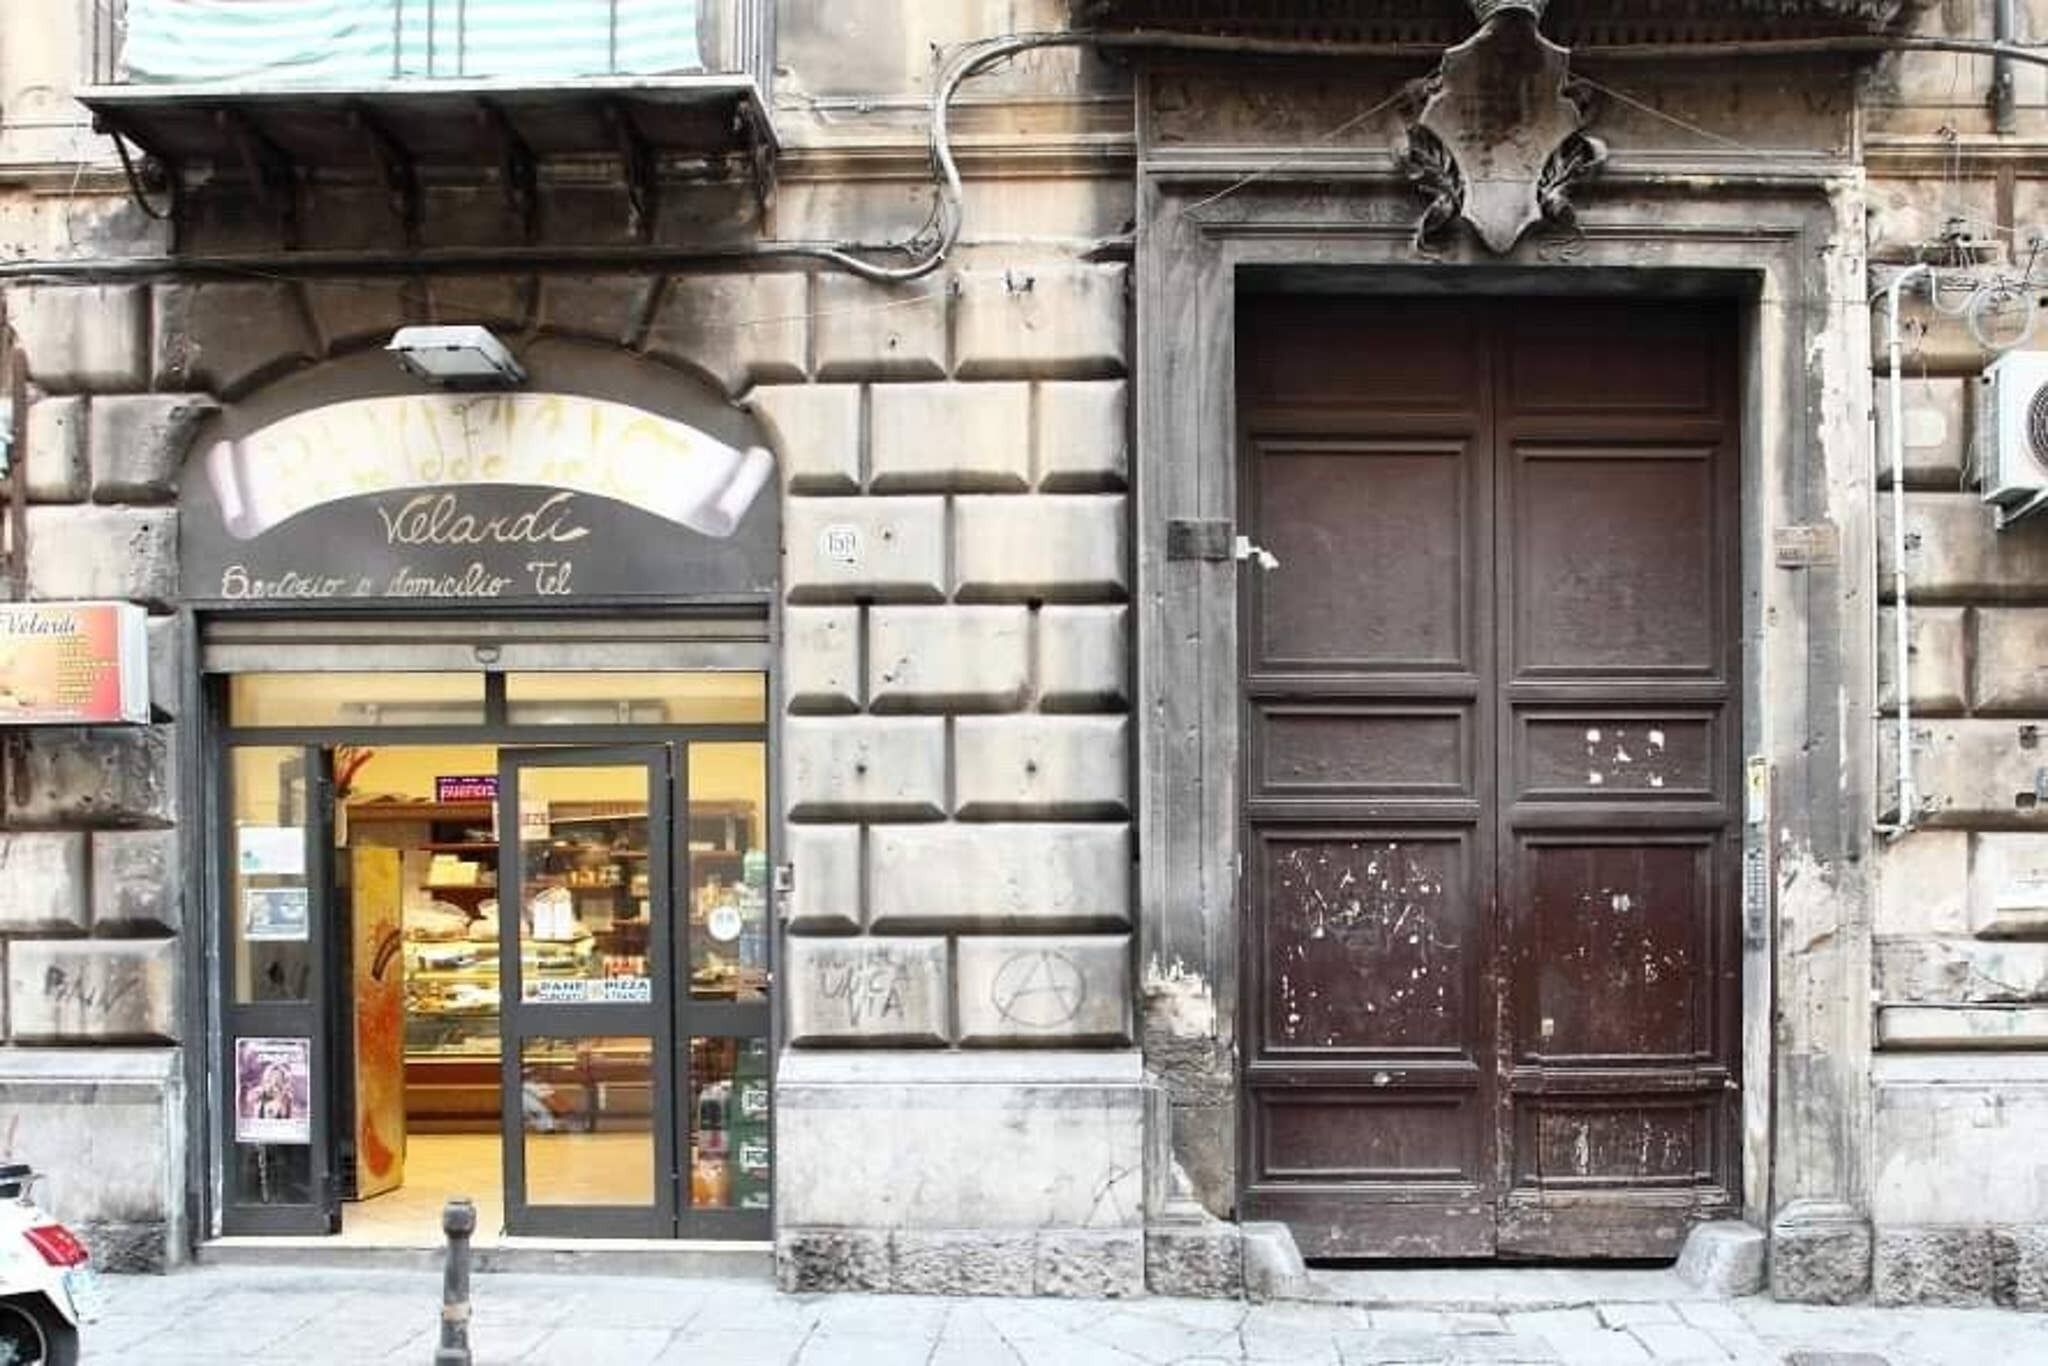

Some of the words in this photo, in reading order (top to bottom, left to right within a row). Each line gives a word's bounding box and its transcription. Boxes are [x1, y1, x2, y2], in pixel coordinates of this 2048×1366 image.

[379, 492, 590, 545] Velardi
[388, 562, 513, 597] domicilio
[526, 561, 573, 596] Tel
[8, 612, 77, 635] Velardi
[605, 981, 648, 991] PIZZA
